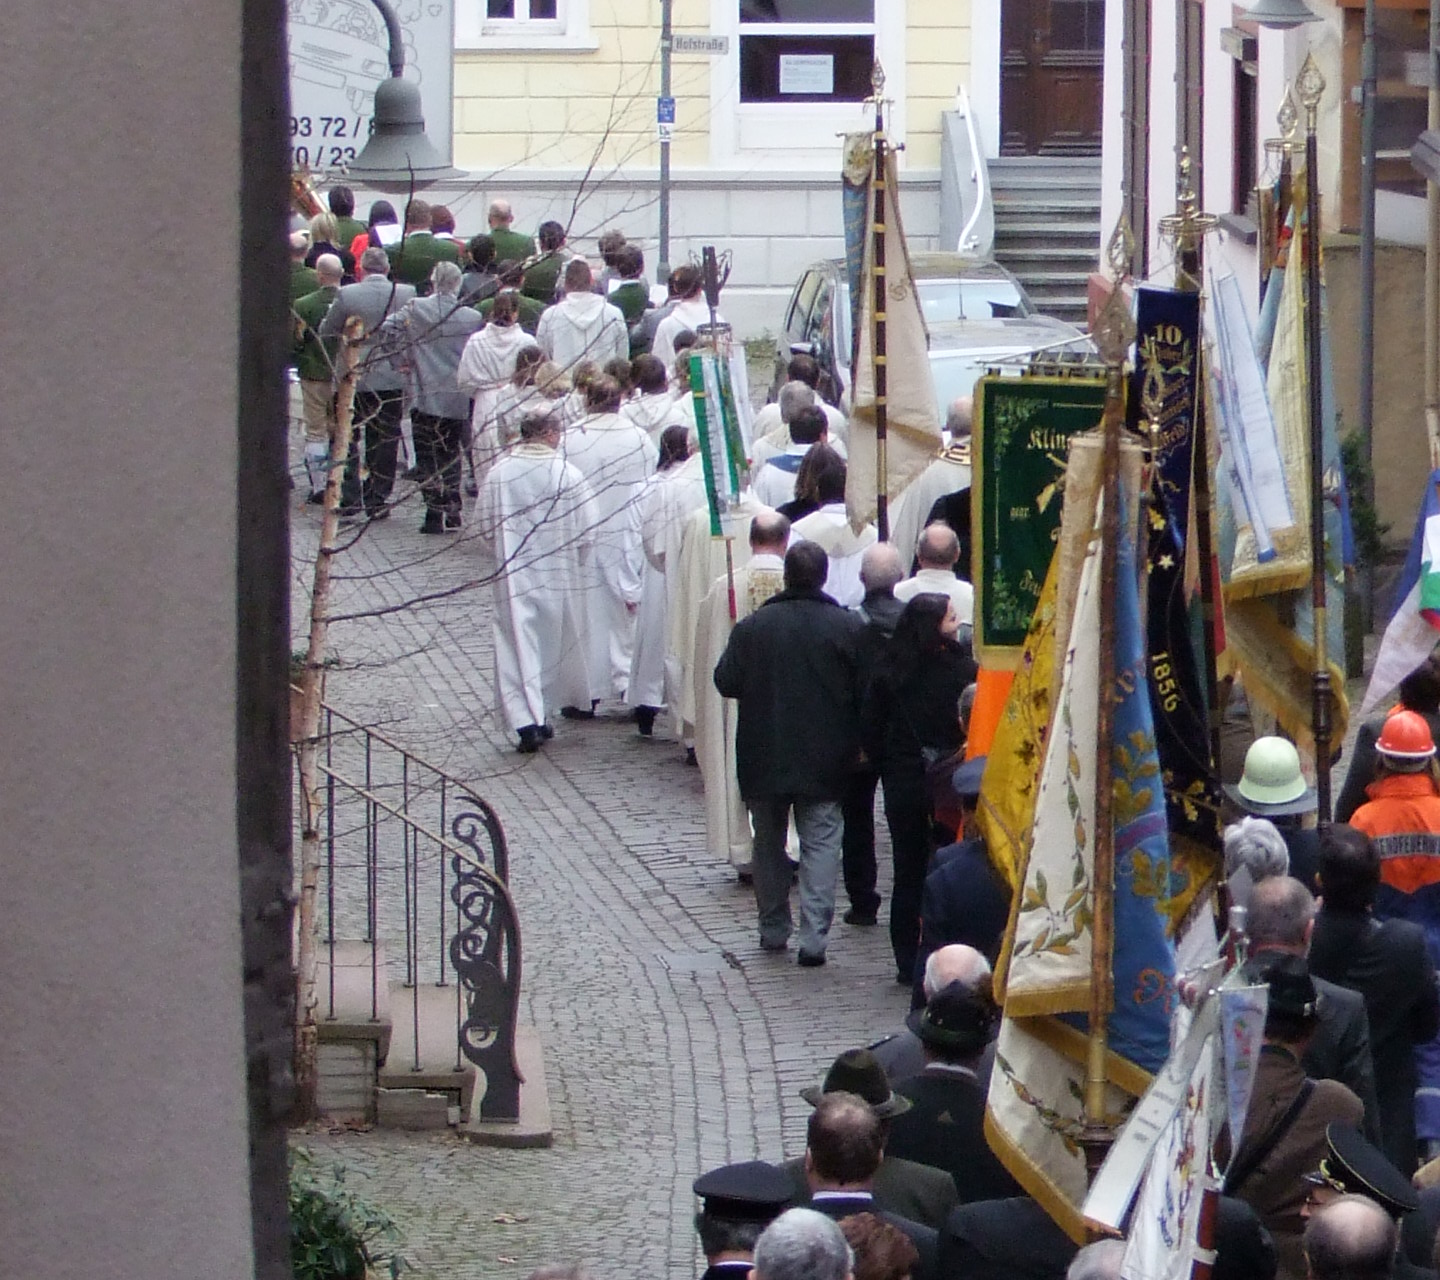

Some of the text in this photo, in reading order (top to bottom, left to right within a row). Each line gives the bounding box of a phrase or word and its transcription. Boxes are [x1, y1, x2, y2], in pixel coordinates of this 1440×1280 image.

[675, 37, 724, 51] Hofstraße
[320, 117, 347, 138] 72
[1152, 651, 1178, 713] 1856
